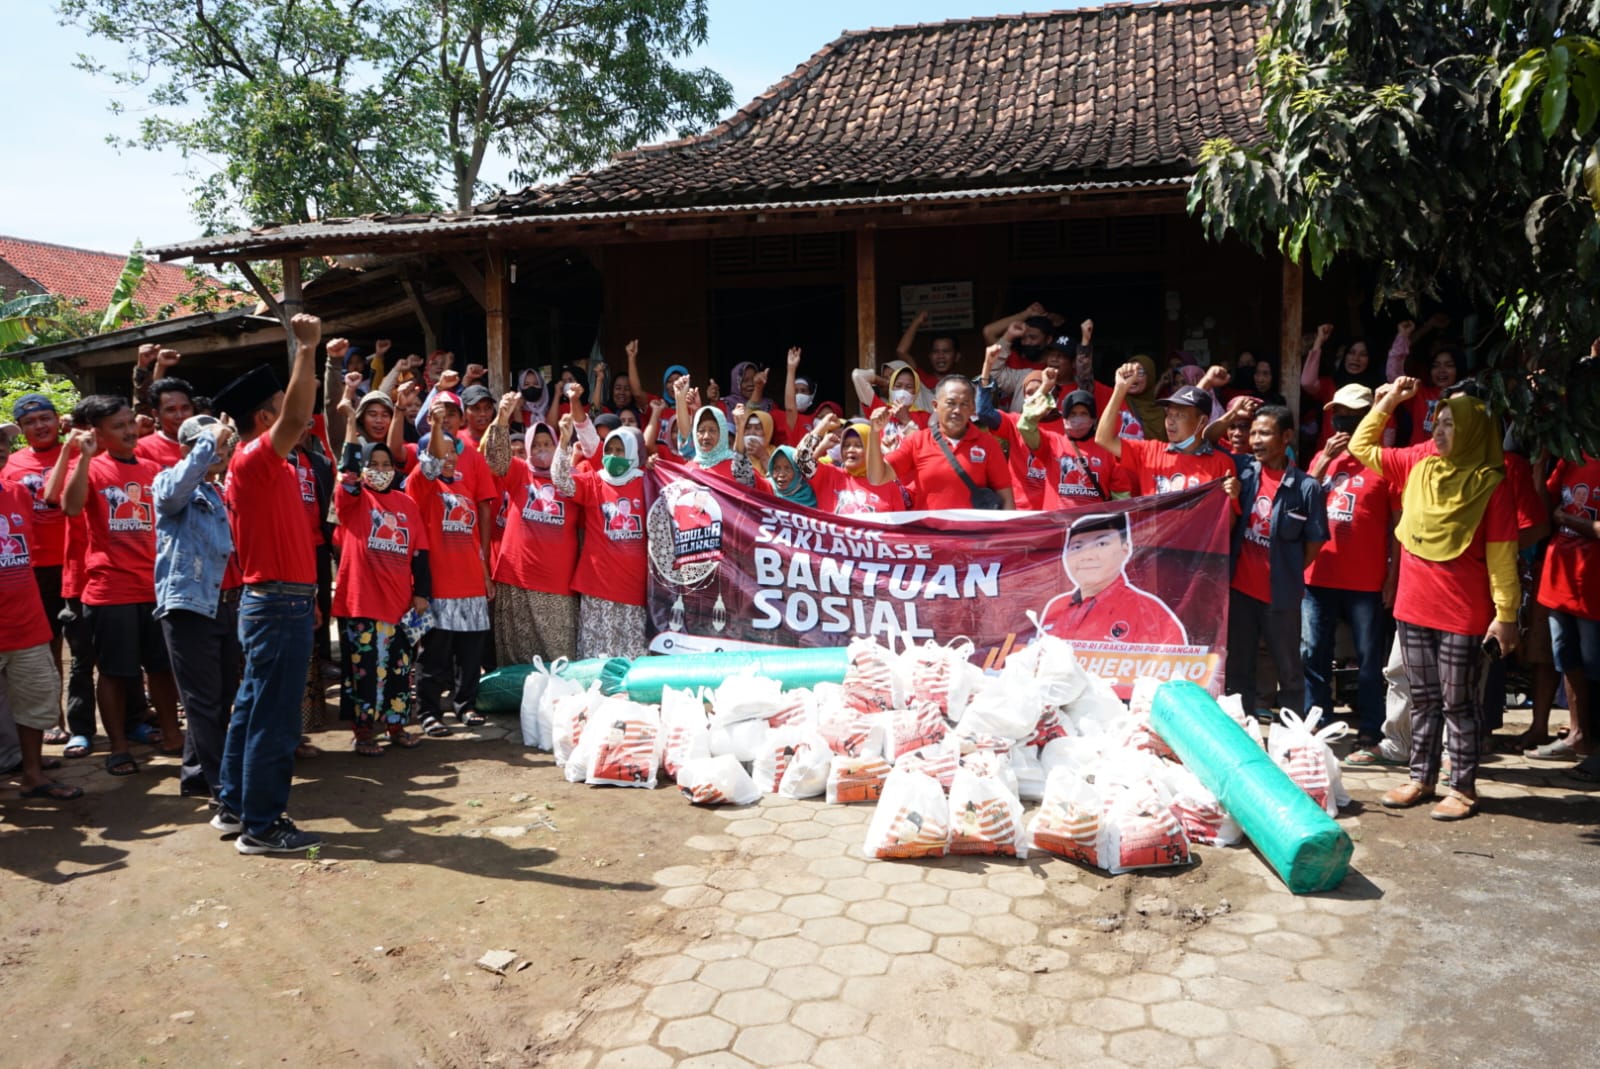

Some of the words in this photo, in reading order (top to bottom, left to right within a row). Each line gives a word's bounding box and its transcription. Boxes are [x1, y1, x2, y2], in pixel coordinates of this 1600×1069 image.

[1058, 486, 1099, 497] HERVIANO
[755, 524, 933, 559] SAKLAWASE
[0, 556, 30, 567] VIANO
[753, 547, 1001, 601] BANTUAN
[752, 588, 935, 639] SOSIAL
[1087, 656, 1207, 680] HERVIANO
